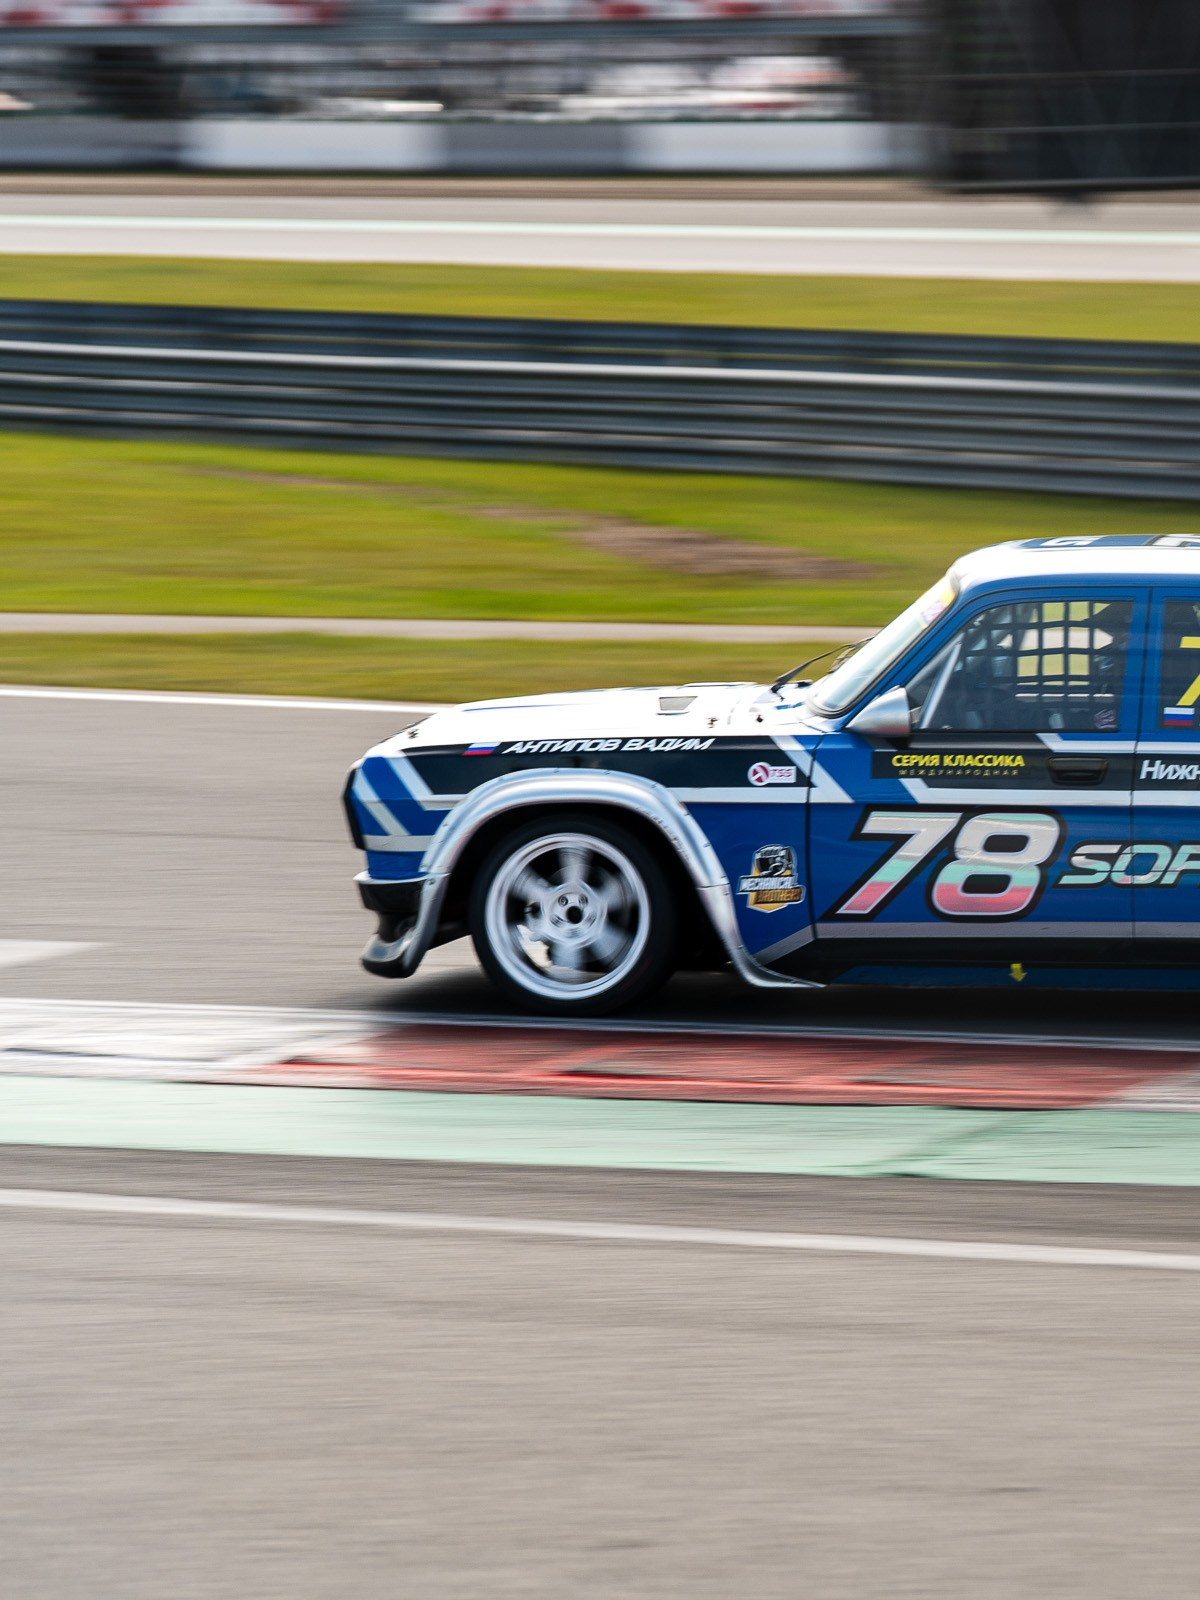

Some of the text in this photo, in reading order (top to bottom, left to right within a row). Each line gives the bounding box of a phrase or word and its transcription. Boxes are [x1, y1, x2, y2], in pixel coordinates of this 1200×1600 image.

[502, 738, 716, 754] АНТИПОВ ВАДИМ
[892, 754, 1026, 767] СЕРИЯ КЛАССИКА
[834, 811, 1061, 917] 78
